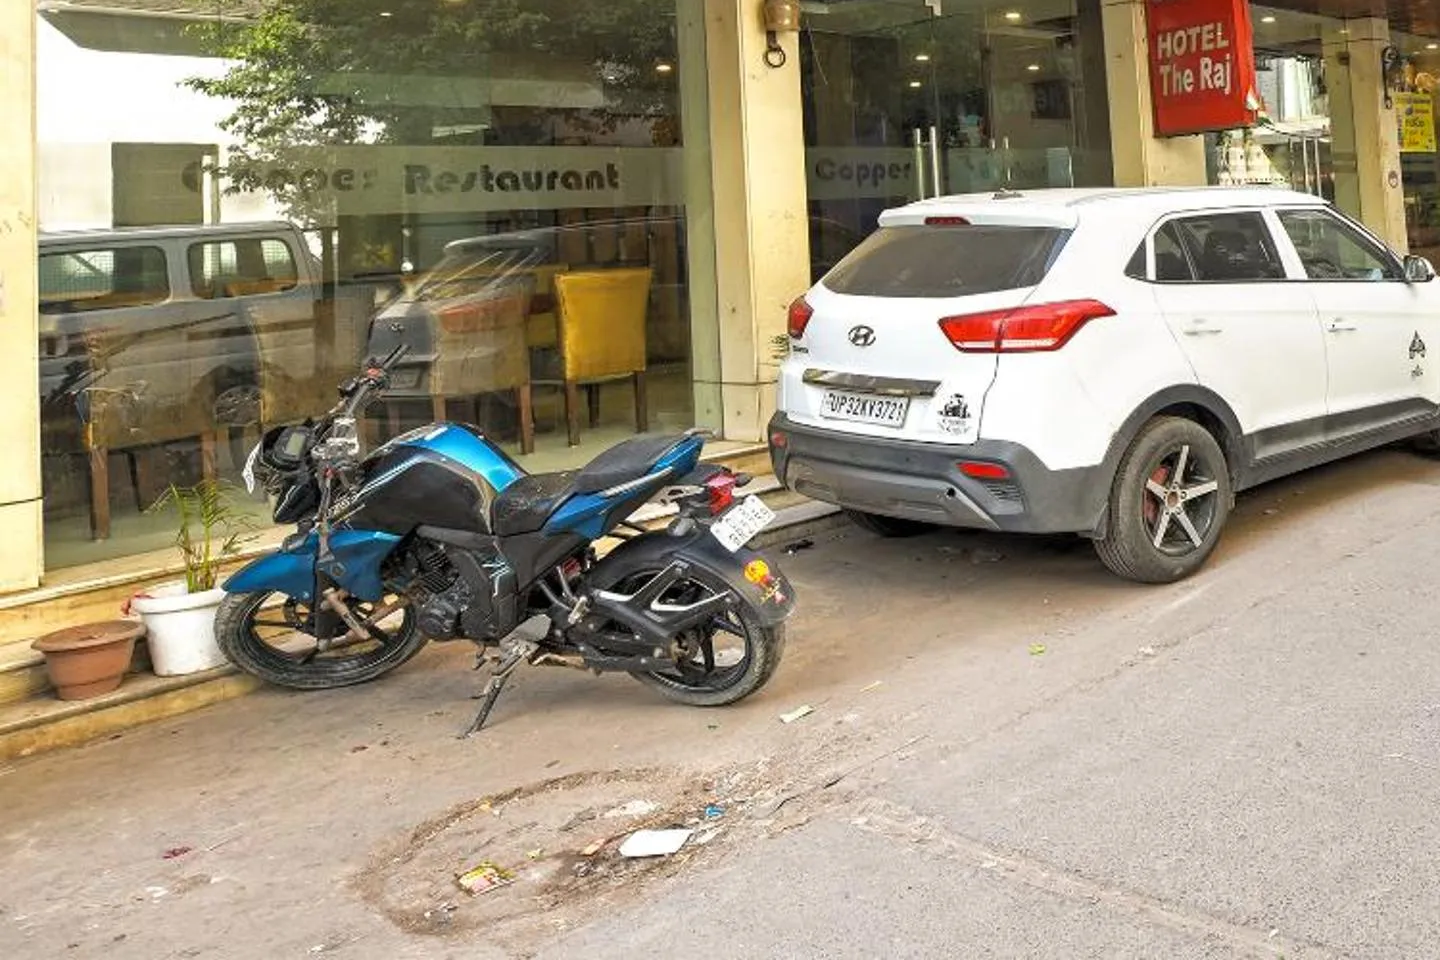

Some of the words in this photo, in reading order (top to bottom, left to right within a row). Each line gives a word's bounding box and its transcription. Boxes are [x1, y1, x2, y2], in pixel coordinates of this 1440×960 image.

[1157, 22, 1230, 60] HOTEL
[1159, 64, 1195, 97] The
[1200, 53, 1233, 96] Raj
[404, 162, 620, 195] Restaurant
